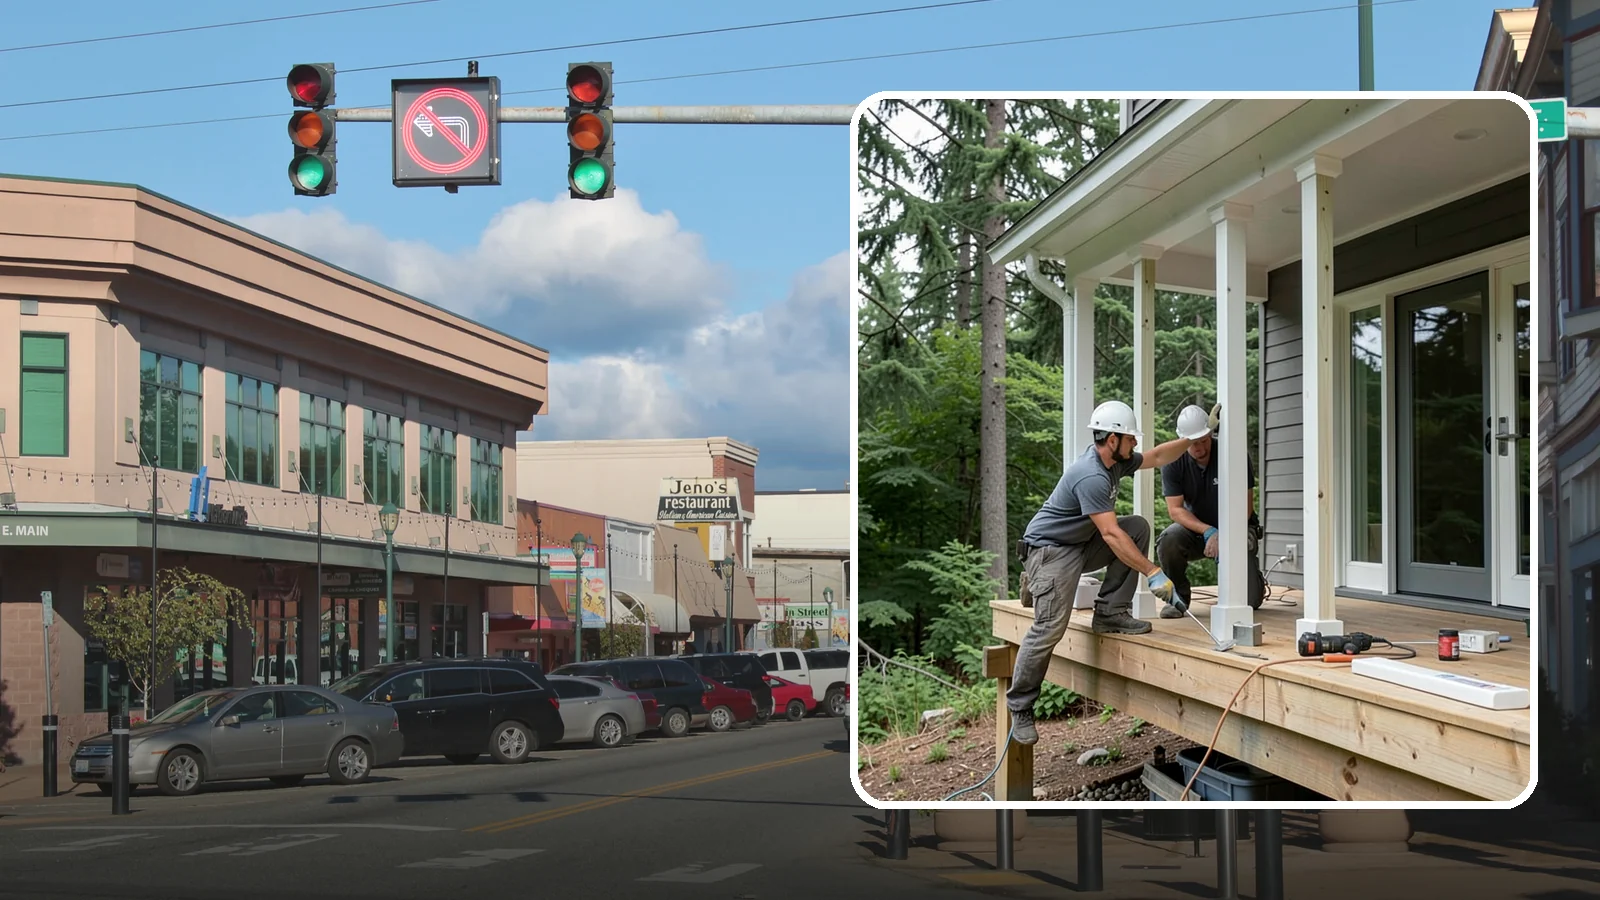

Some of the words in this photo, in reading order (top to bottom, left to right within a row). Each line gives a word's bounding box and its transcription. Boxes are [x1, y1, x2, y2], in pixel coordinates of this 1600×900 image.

[670, 480, 728, 494] Jeno's
[665, 497, 731, 509] restaurant
[658, 510, 681, 519] Italian
[686, 510, 714, 519] American
[715, 509, 737, 519] Cuisine
[2, 525, 13, 536] E.
[16, 525, 49, 536] MAIN
[797, 608, 828, 616] Street
